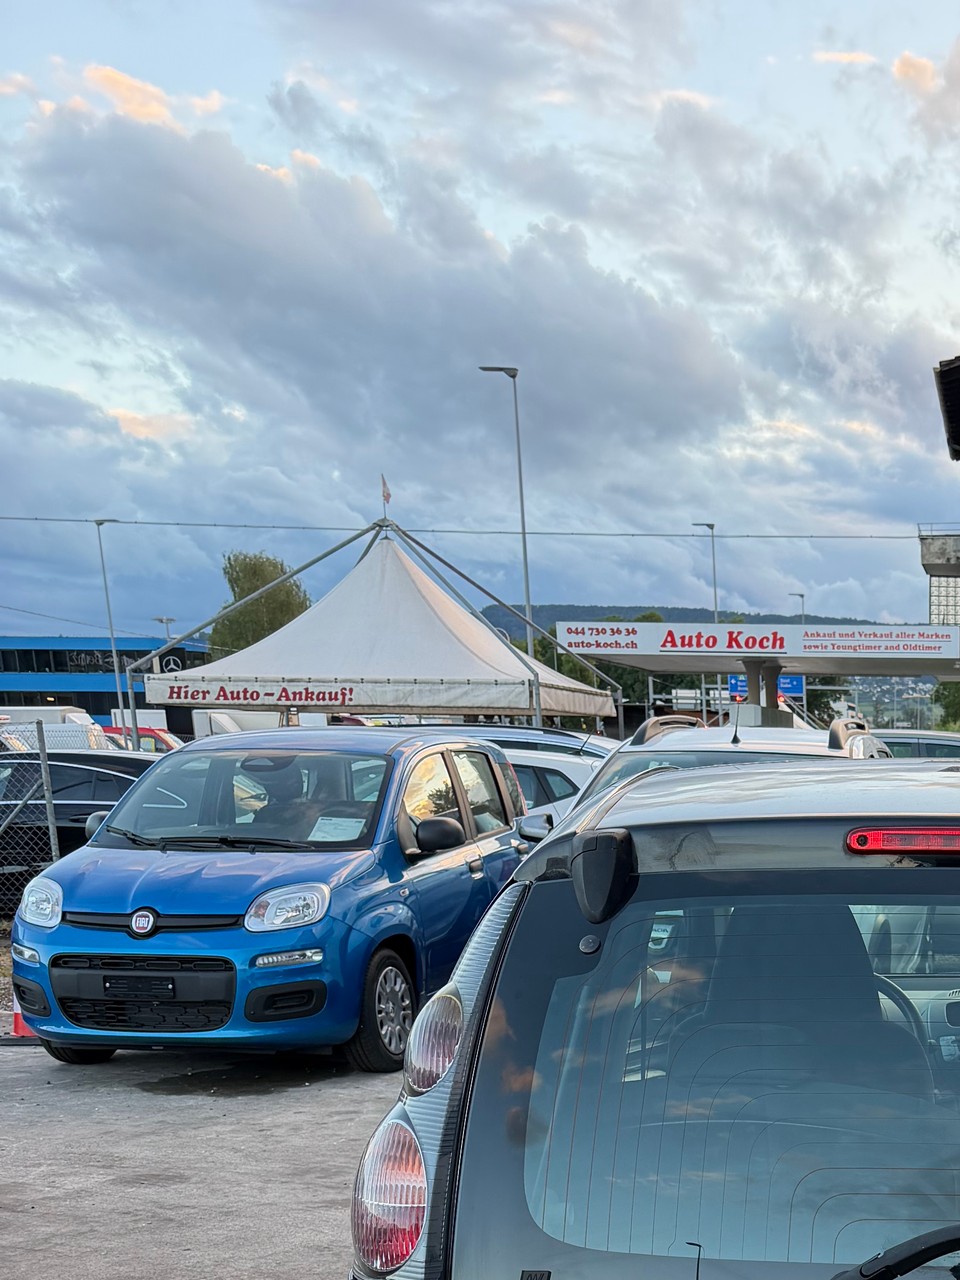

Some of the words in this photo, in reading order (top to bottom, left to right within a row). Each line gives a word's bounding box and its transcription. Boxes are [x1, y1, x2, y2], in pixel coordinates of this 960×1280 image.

[566, 627, 585, 636] 044
[587, 627, 607, 636] 730
[608, 627, 622, 636] 36
[624, 627, 638, 636] 36
[803, 631, 836, 639] Ankauf
[838, 631, 856, 639] und
[857, 631, 893, 639] Verkauf
[917, 632, 952, 640] Marken
[660, 629, 718, 649] Auto
[726, 630, 785, 650] Koch
[567, 640, 638, 649] auto-koch.ch
[830, 643, 882, 652] Youngtimer
[167, 685, 210, 700] Hier
[136, 917, 149, 928] FIAT
